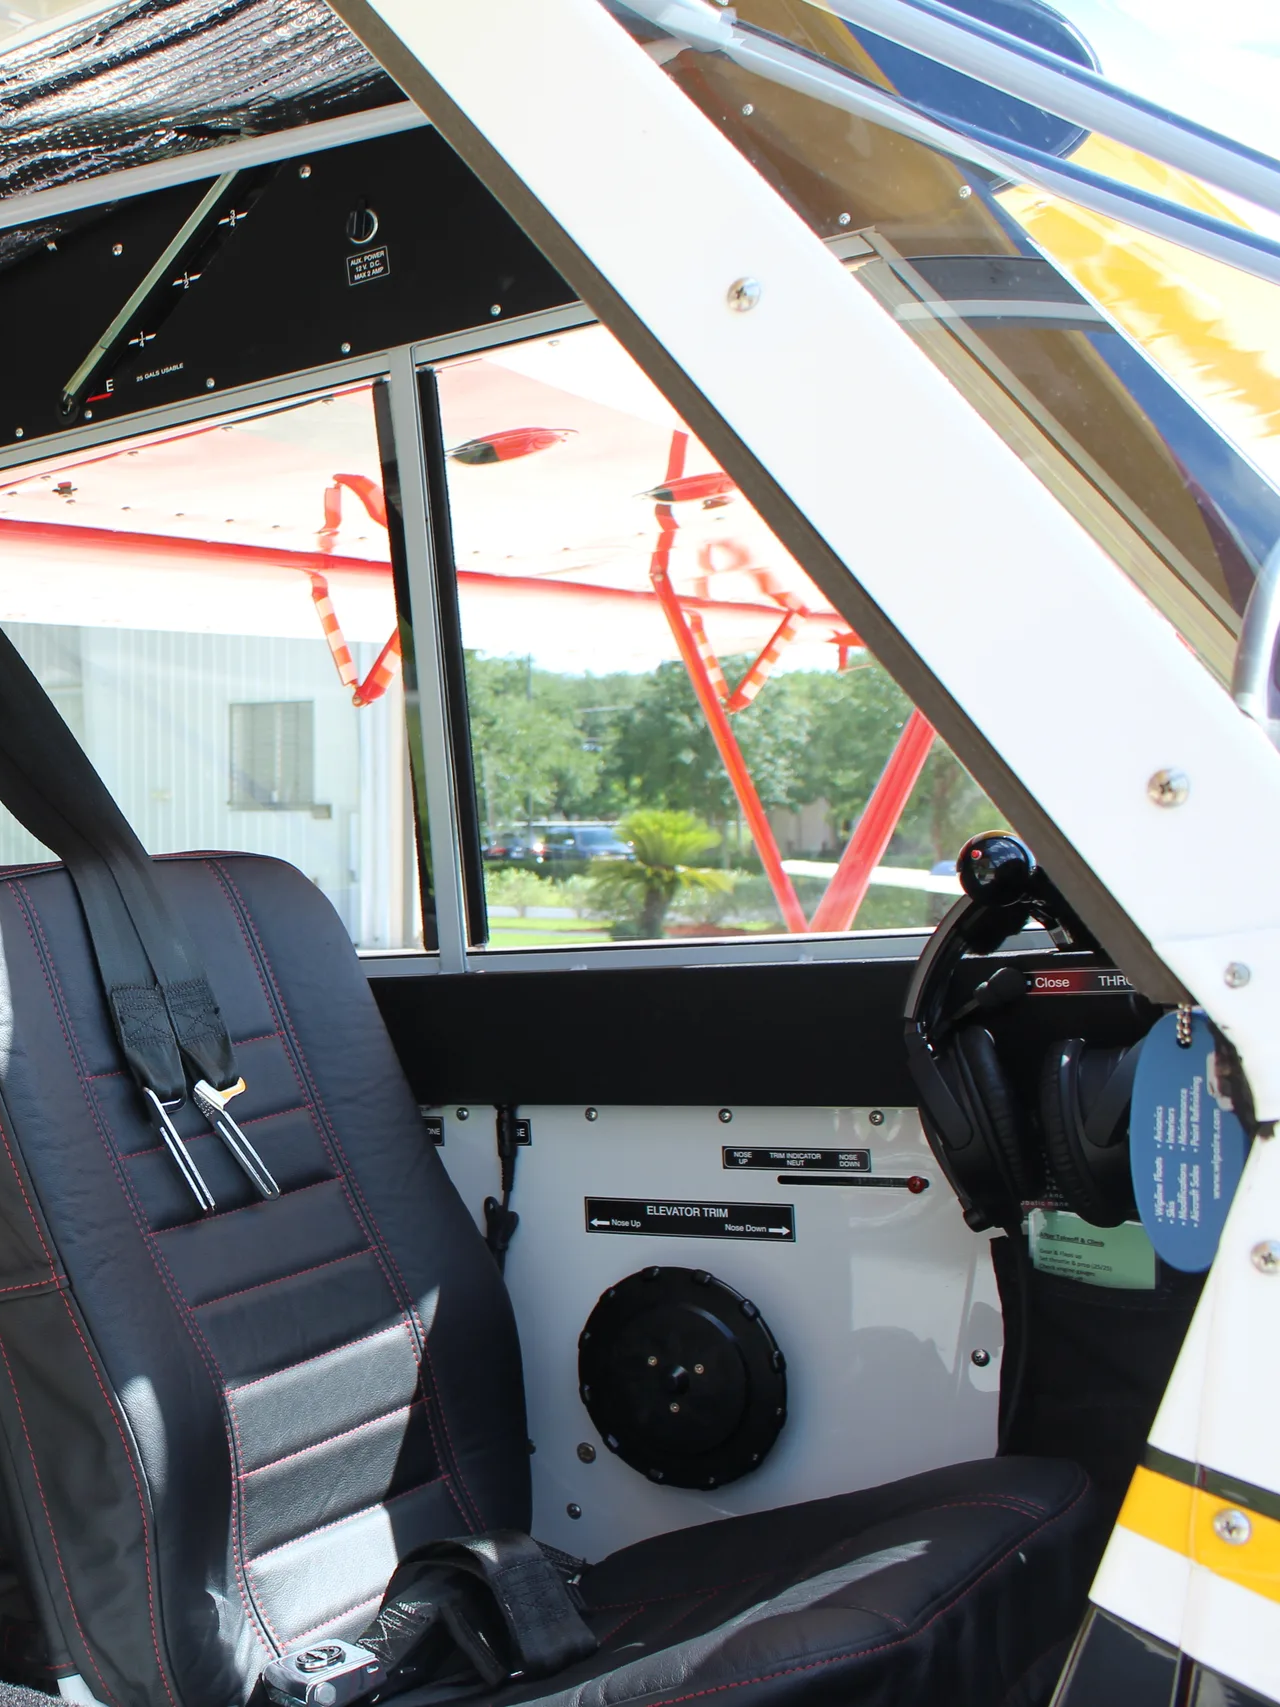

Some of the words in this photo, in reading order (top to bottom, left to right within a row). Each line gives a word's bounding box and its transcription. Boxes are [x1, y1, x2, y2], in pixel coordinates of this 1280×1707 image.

[364, 251, 384, 261] POWER
[354, 272, 366, 280] MAX
[372, 267, 384, 275] AMP
[144, 370, 160, 379] GALS
[161, 362, 184, 374] USABLE
[106, 378, 114, 392] E
[1035, 977, 1070, 988] Close
[1178, 1088, 1189, 1146] Maintenance
[1190, 1123, 1201, 1147] Paint
[786, 1152, 821, 1160] INDICATOR
[839, 1160, 861, 1168] DOWN
[1190, 1164, 1201, 1189] Sales
[1177, 1163, 1188, 1220] Modifications
[646, 1205, 701, 1217] ELEVATOR
[703, 1208, 729, 1218] TRIM
[1189, 1188, 1200, 1222] Aircraft
[611, 1218, 630, 1227] Nose
[631, 1219, 642, 1229] Up
[724, 1223, 744, 1232] Nose
[745, 1224, 767, 1233] Down
